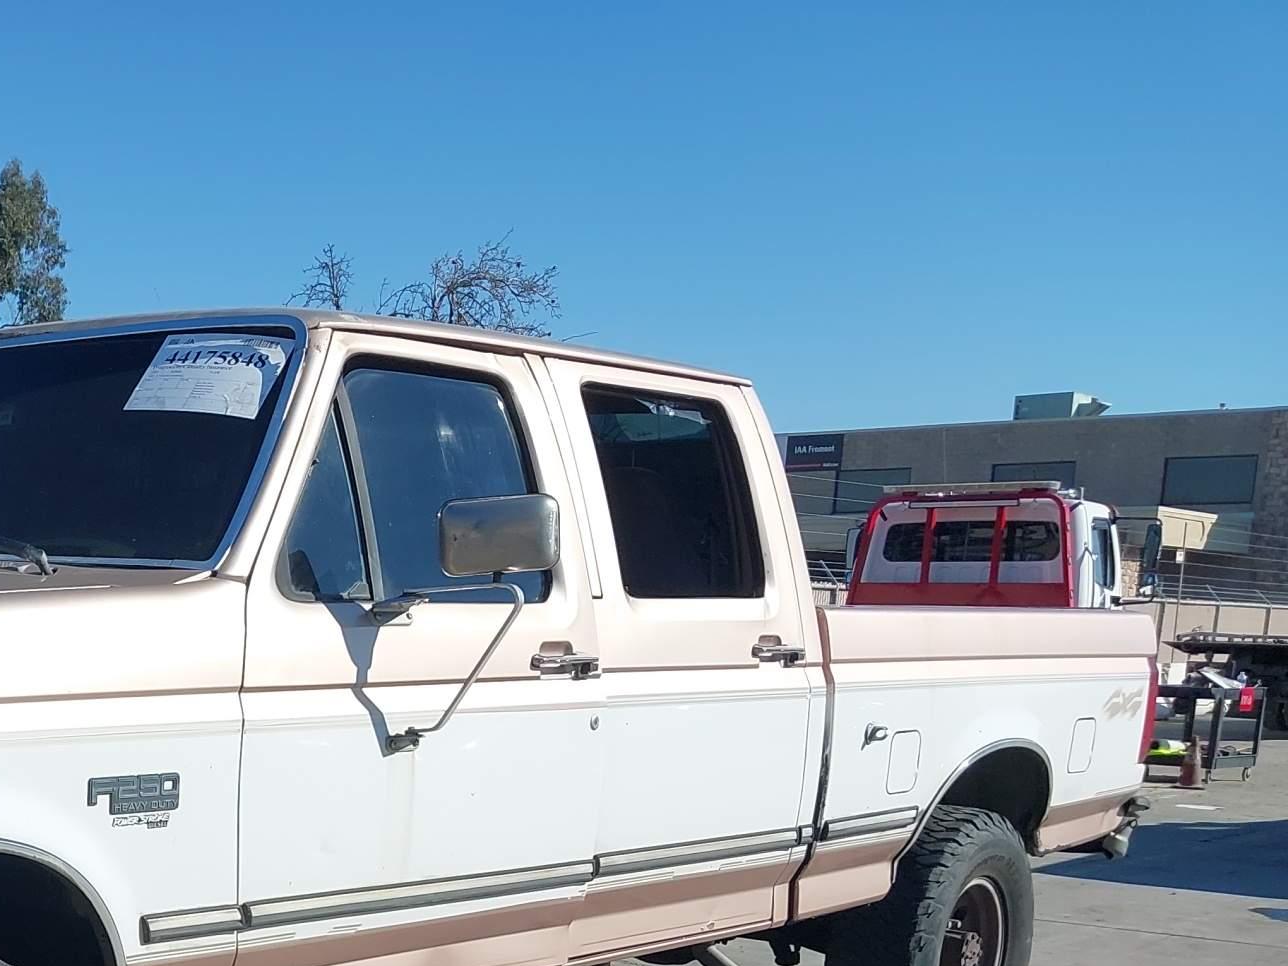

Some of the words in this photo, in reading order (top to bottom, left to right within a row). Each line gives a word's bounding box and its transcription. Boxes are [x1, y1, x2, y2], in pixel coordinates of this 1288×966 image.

[164, 350, 269, 369] 44175848
[794, 445, 807, 454] IAA
[113, 801, 148, 813] HEAVY
[151, 799, 177, 809] DUTY
